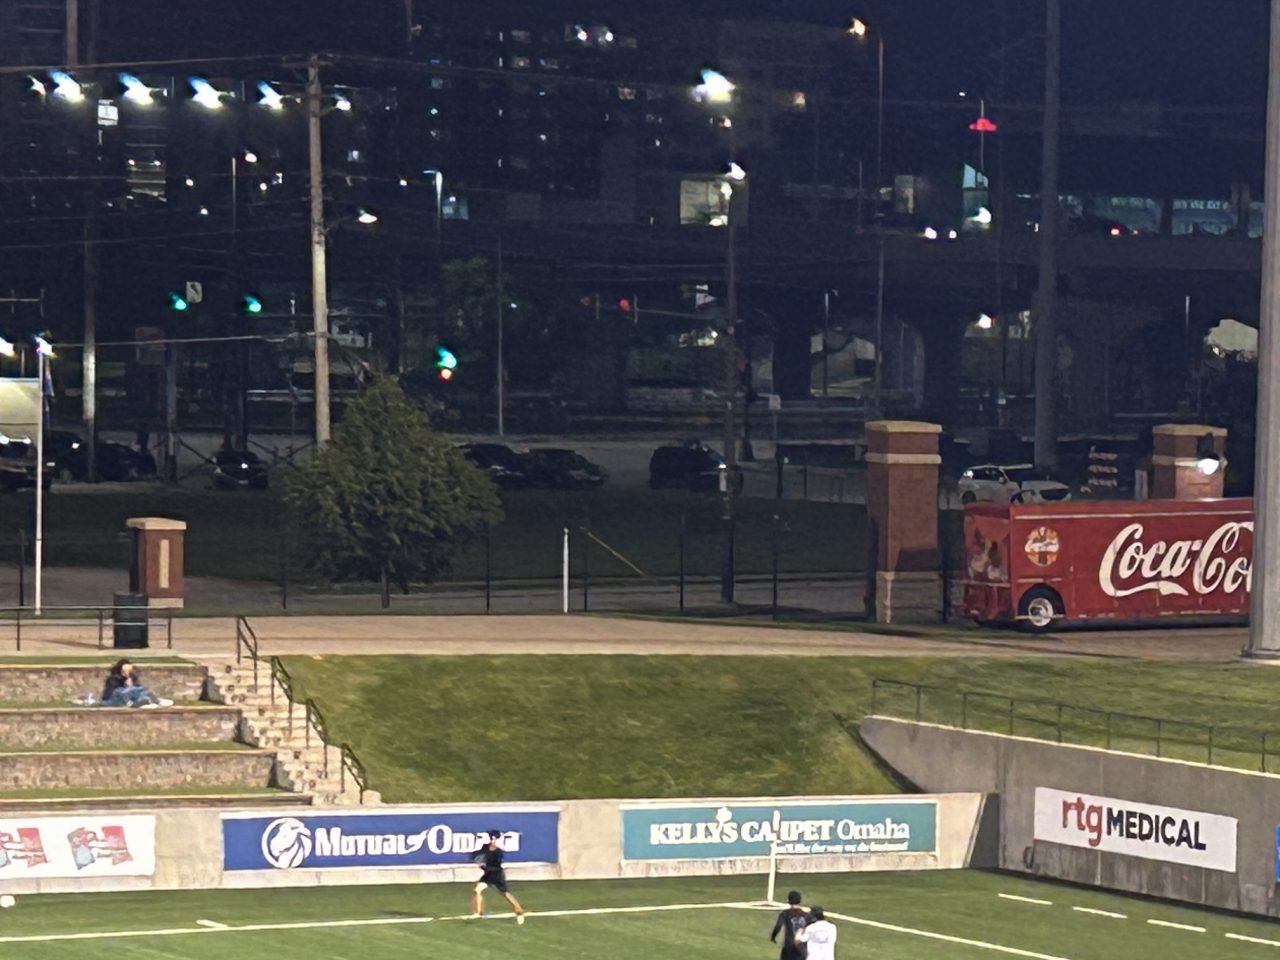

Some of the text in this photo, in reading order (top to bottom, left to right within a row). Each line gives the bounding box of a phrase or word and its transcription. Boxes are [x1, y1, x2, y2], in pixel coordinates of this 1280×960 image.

[1098, 521, 1255, 598] Coca-Co
[837, 817, 910, 840] Omaha
[1062, 797, 1207, 851] rtg MEDICAL
